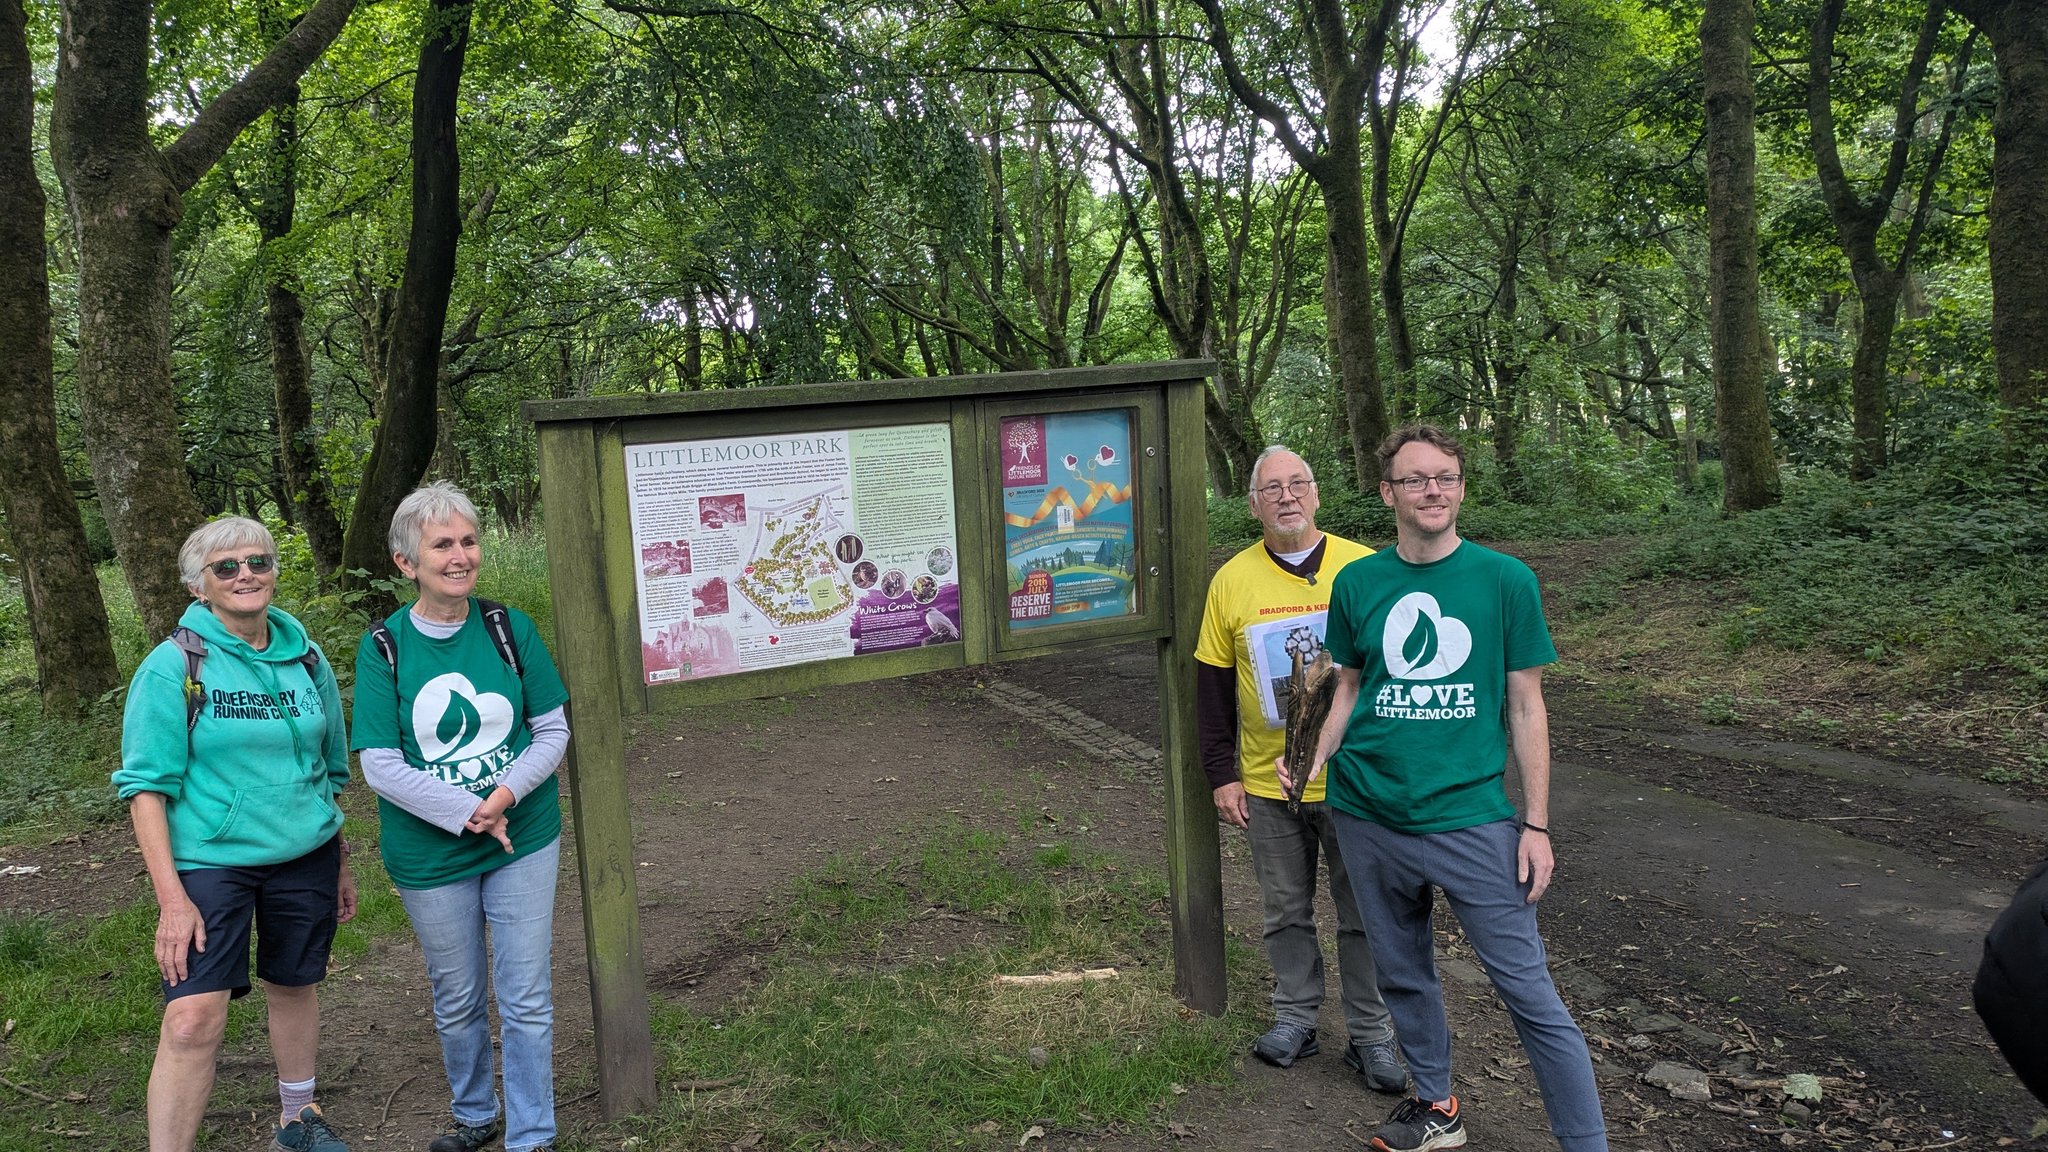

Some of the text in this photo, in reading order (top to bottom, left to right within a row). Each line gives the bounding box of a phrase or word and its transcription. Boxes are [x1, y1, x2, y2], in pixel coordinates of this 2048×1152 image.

[633, 438, 844, 468] LITTLEMOOR PARK
[1028, 578, 1047, 587] 20th
[1028, 585, 1048, 594] JULY
[1011, 593, 1051, 607] RESERVE
[859, 602, 918, 615] White Crows
[1011, 605, 1051, 618] THE DATE!
[1260, 605, 1304, 615] BRADFORD
[1314, 603, 1330, 611] KEI
[213, 704, 270, 720] RUNNING
[1375, 706, 1476, 720] LITTLEMOOR
